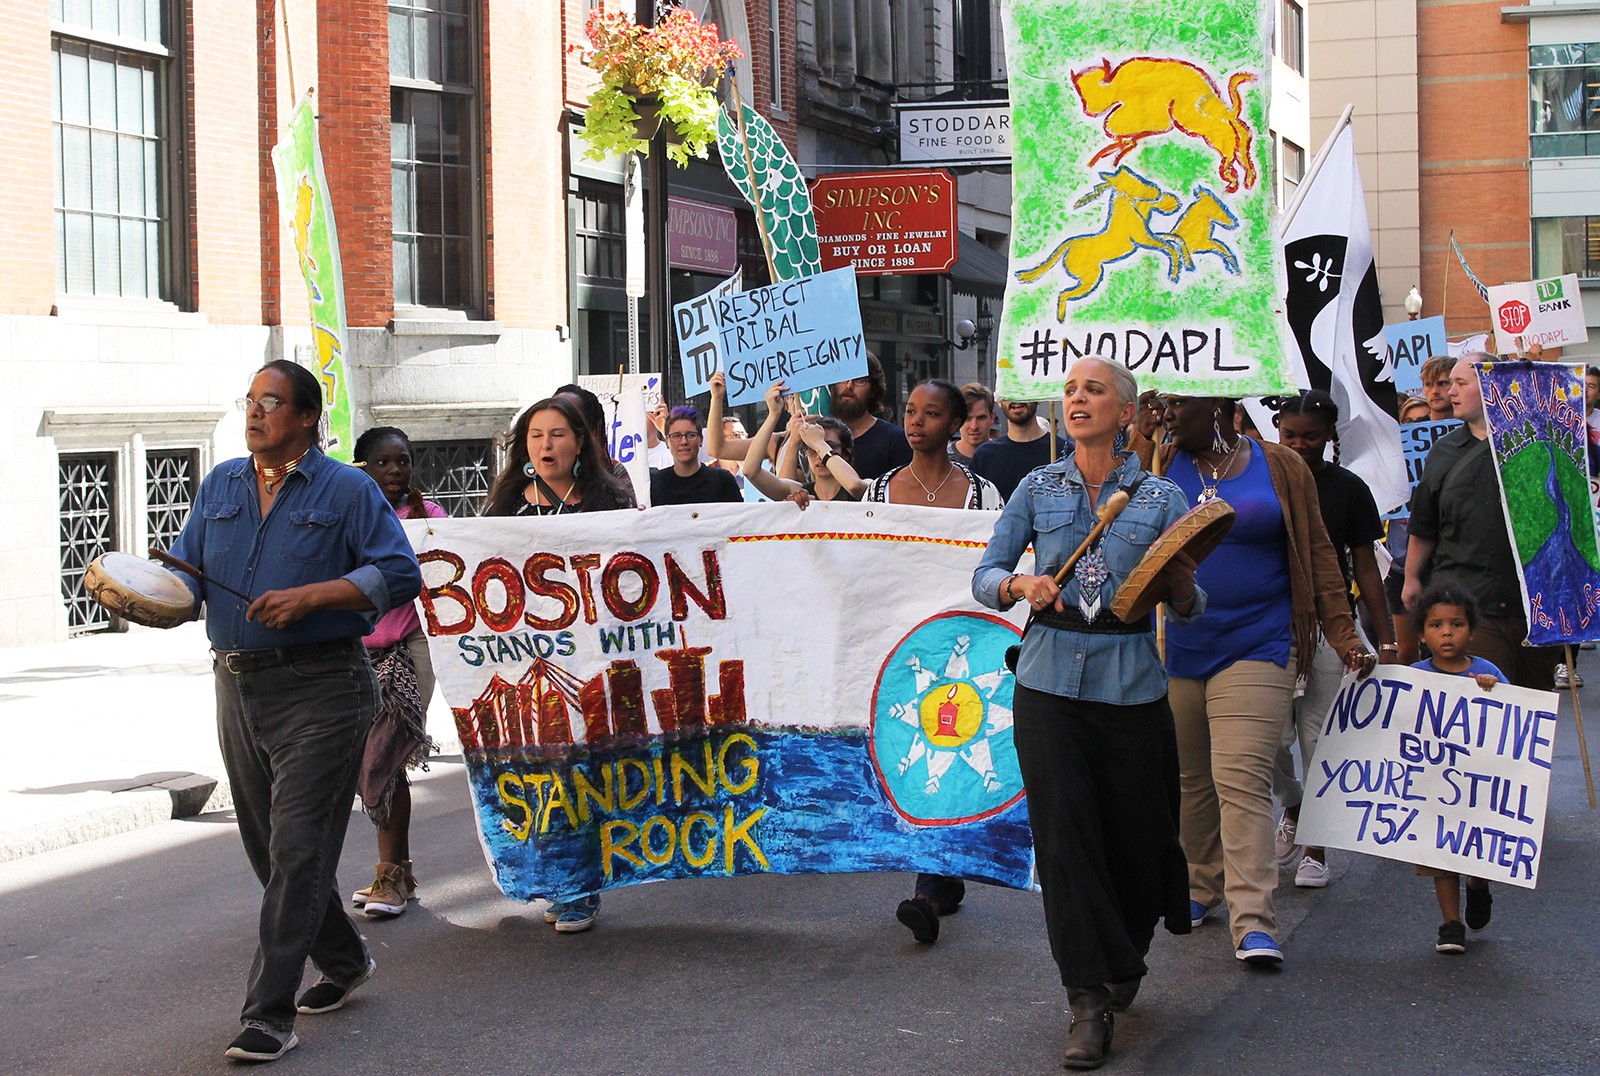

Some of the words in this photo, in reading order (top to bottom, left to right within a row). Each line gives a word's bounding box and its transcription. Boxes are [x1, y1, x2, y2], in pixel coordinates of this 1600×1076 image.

[919, 137, 947, 147] FINE
[956, 135, 993, 146] FOOD
[997, 134, 1006, 144] &
[825, 184, 941, 208] SIMPSON'S
[818, 234, 867, 243] DIAMONDS
[876, 232, 899, 240] FINE
[903, 230, 948, 239] JEWELRY
[862, 210, 903, 231] INC.
[681, 245, 702, 261] SINCE
[832, 245, 860, 257] BUY
[867, 244, 887, 255] OR
[894, 242, 932, 254] LOAN
[850, 258, 885, 268] SINCE
[891, 257, 915, 267] 1898
[718, 278, 813, 328] RESPECT
[1539, 280, 1559, 299] TD
[1539, 299, 1572, 313] BANK
[719, 310, 816, 356] TRIBAL
[1501, 306, 1527, 328] STOP
[686, 341, 718, 385] TD
[728, 333, 862, 398] SOVEREIGNTY
[1020, 326, 1250, 377] #NODAPL
[416, 548, 727, 637] BOSTON
[458, 630, 577, 666] STANDS
[599, 621, 677, 654] WITH
[1325, 677, 1413, 736] NOT
[1414, 688, 1558, 770] NATIVE
[1399, 732, 1471, 767] BUT
[497, 732, 760, 843] STANDING
[1315, 757, 1427, 802] YOU'RE
[1437, 768, 1534, 825] STILL
[601, 804, 771, 881] ROCK
[1345, 800, 1420, 845] 75%
[1435, 815, 1538, 880] WATER
